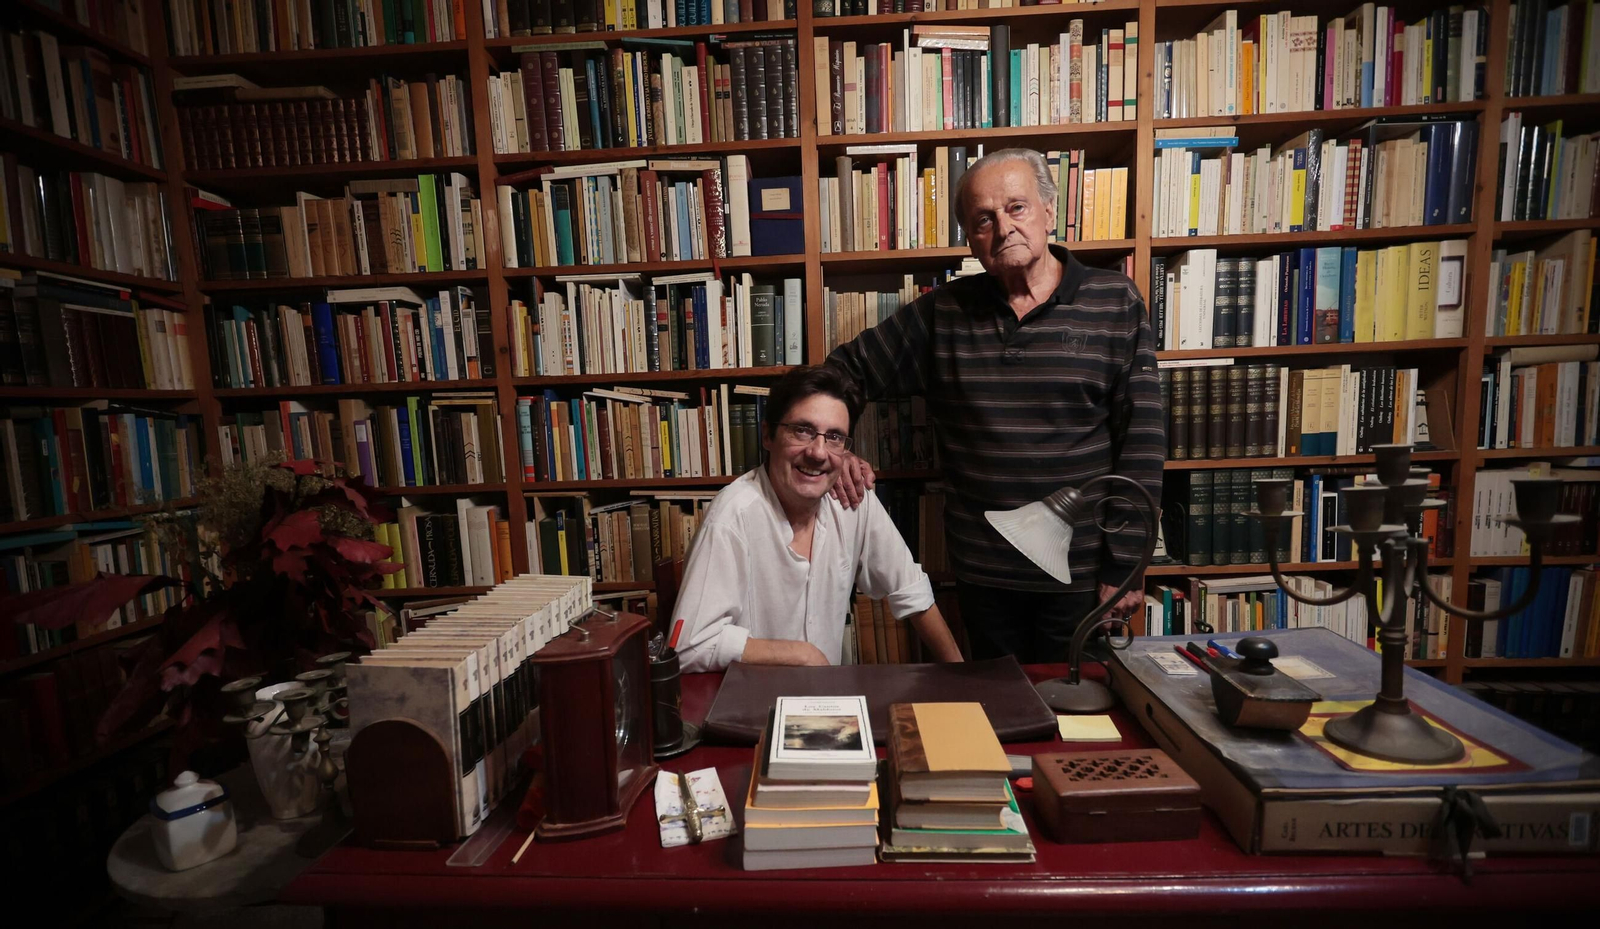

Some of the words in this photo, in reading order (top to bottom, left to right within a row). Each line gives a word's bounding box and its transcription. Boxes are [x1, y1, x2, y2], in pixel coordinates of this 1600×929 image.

[955, 152, 960, 161] 1
[1418, 249, 1432, 291] IDEAS
[454, 323, 461, 332] EL
[424, 516, 434, 541] PROSA
[651, 510, 660, 547] NARRATIVA
[427, 550, 438, 588] CERNUDA
[449, 548, 460, 586] CERNUDA
[1317, 820, 1393, 839] ARTES
